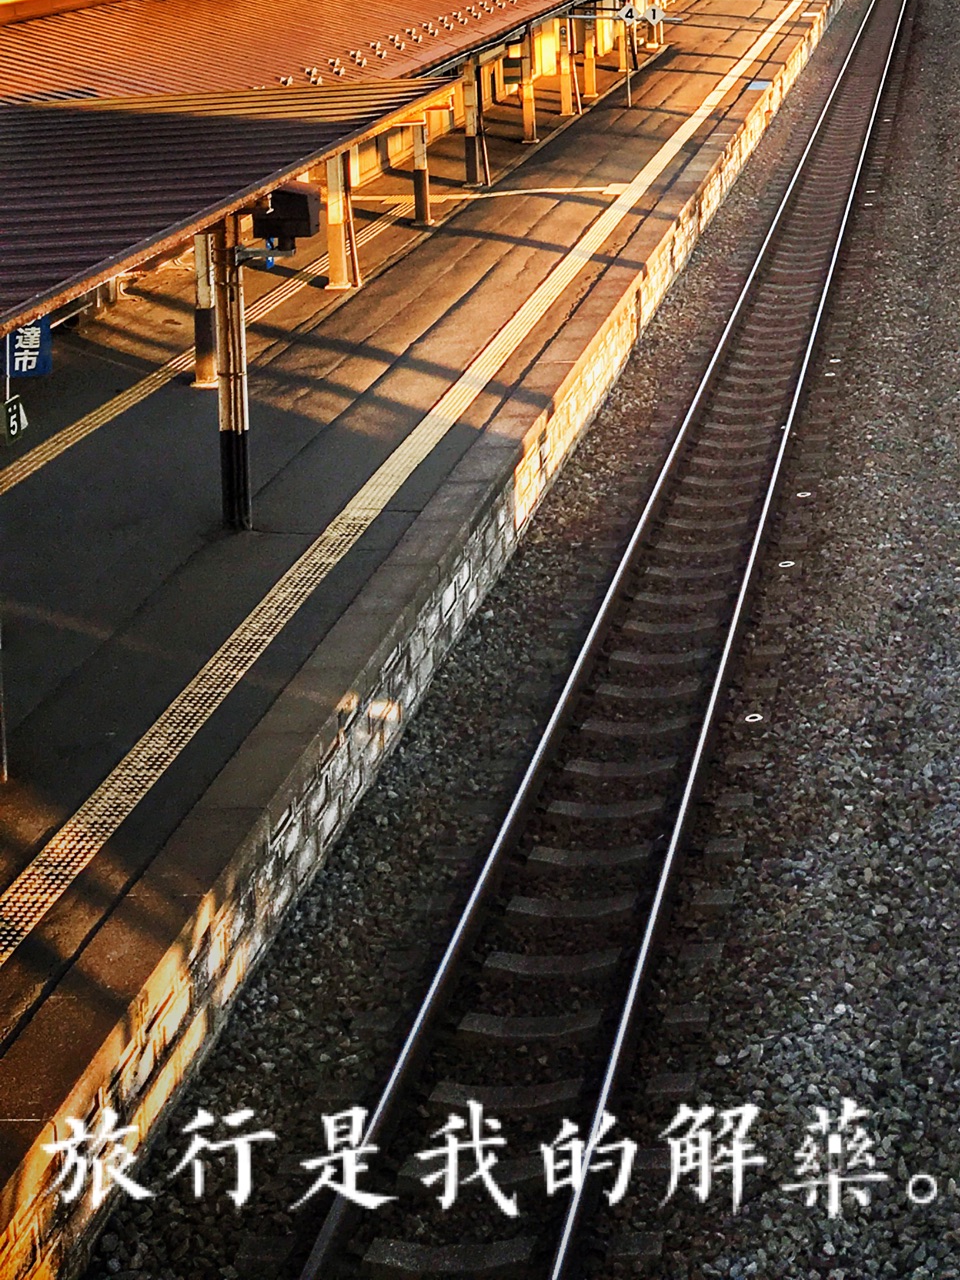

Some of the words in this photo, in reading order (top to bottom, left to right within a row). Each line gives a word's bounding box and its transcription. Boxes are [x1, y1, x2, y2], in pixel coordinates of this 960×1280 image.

[625, 8, 634, 19] 4
[651, 8, 657, 20] 1
[14, 319, 41, 372] 達市
[10, 413, 18, 436] 5
